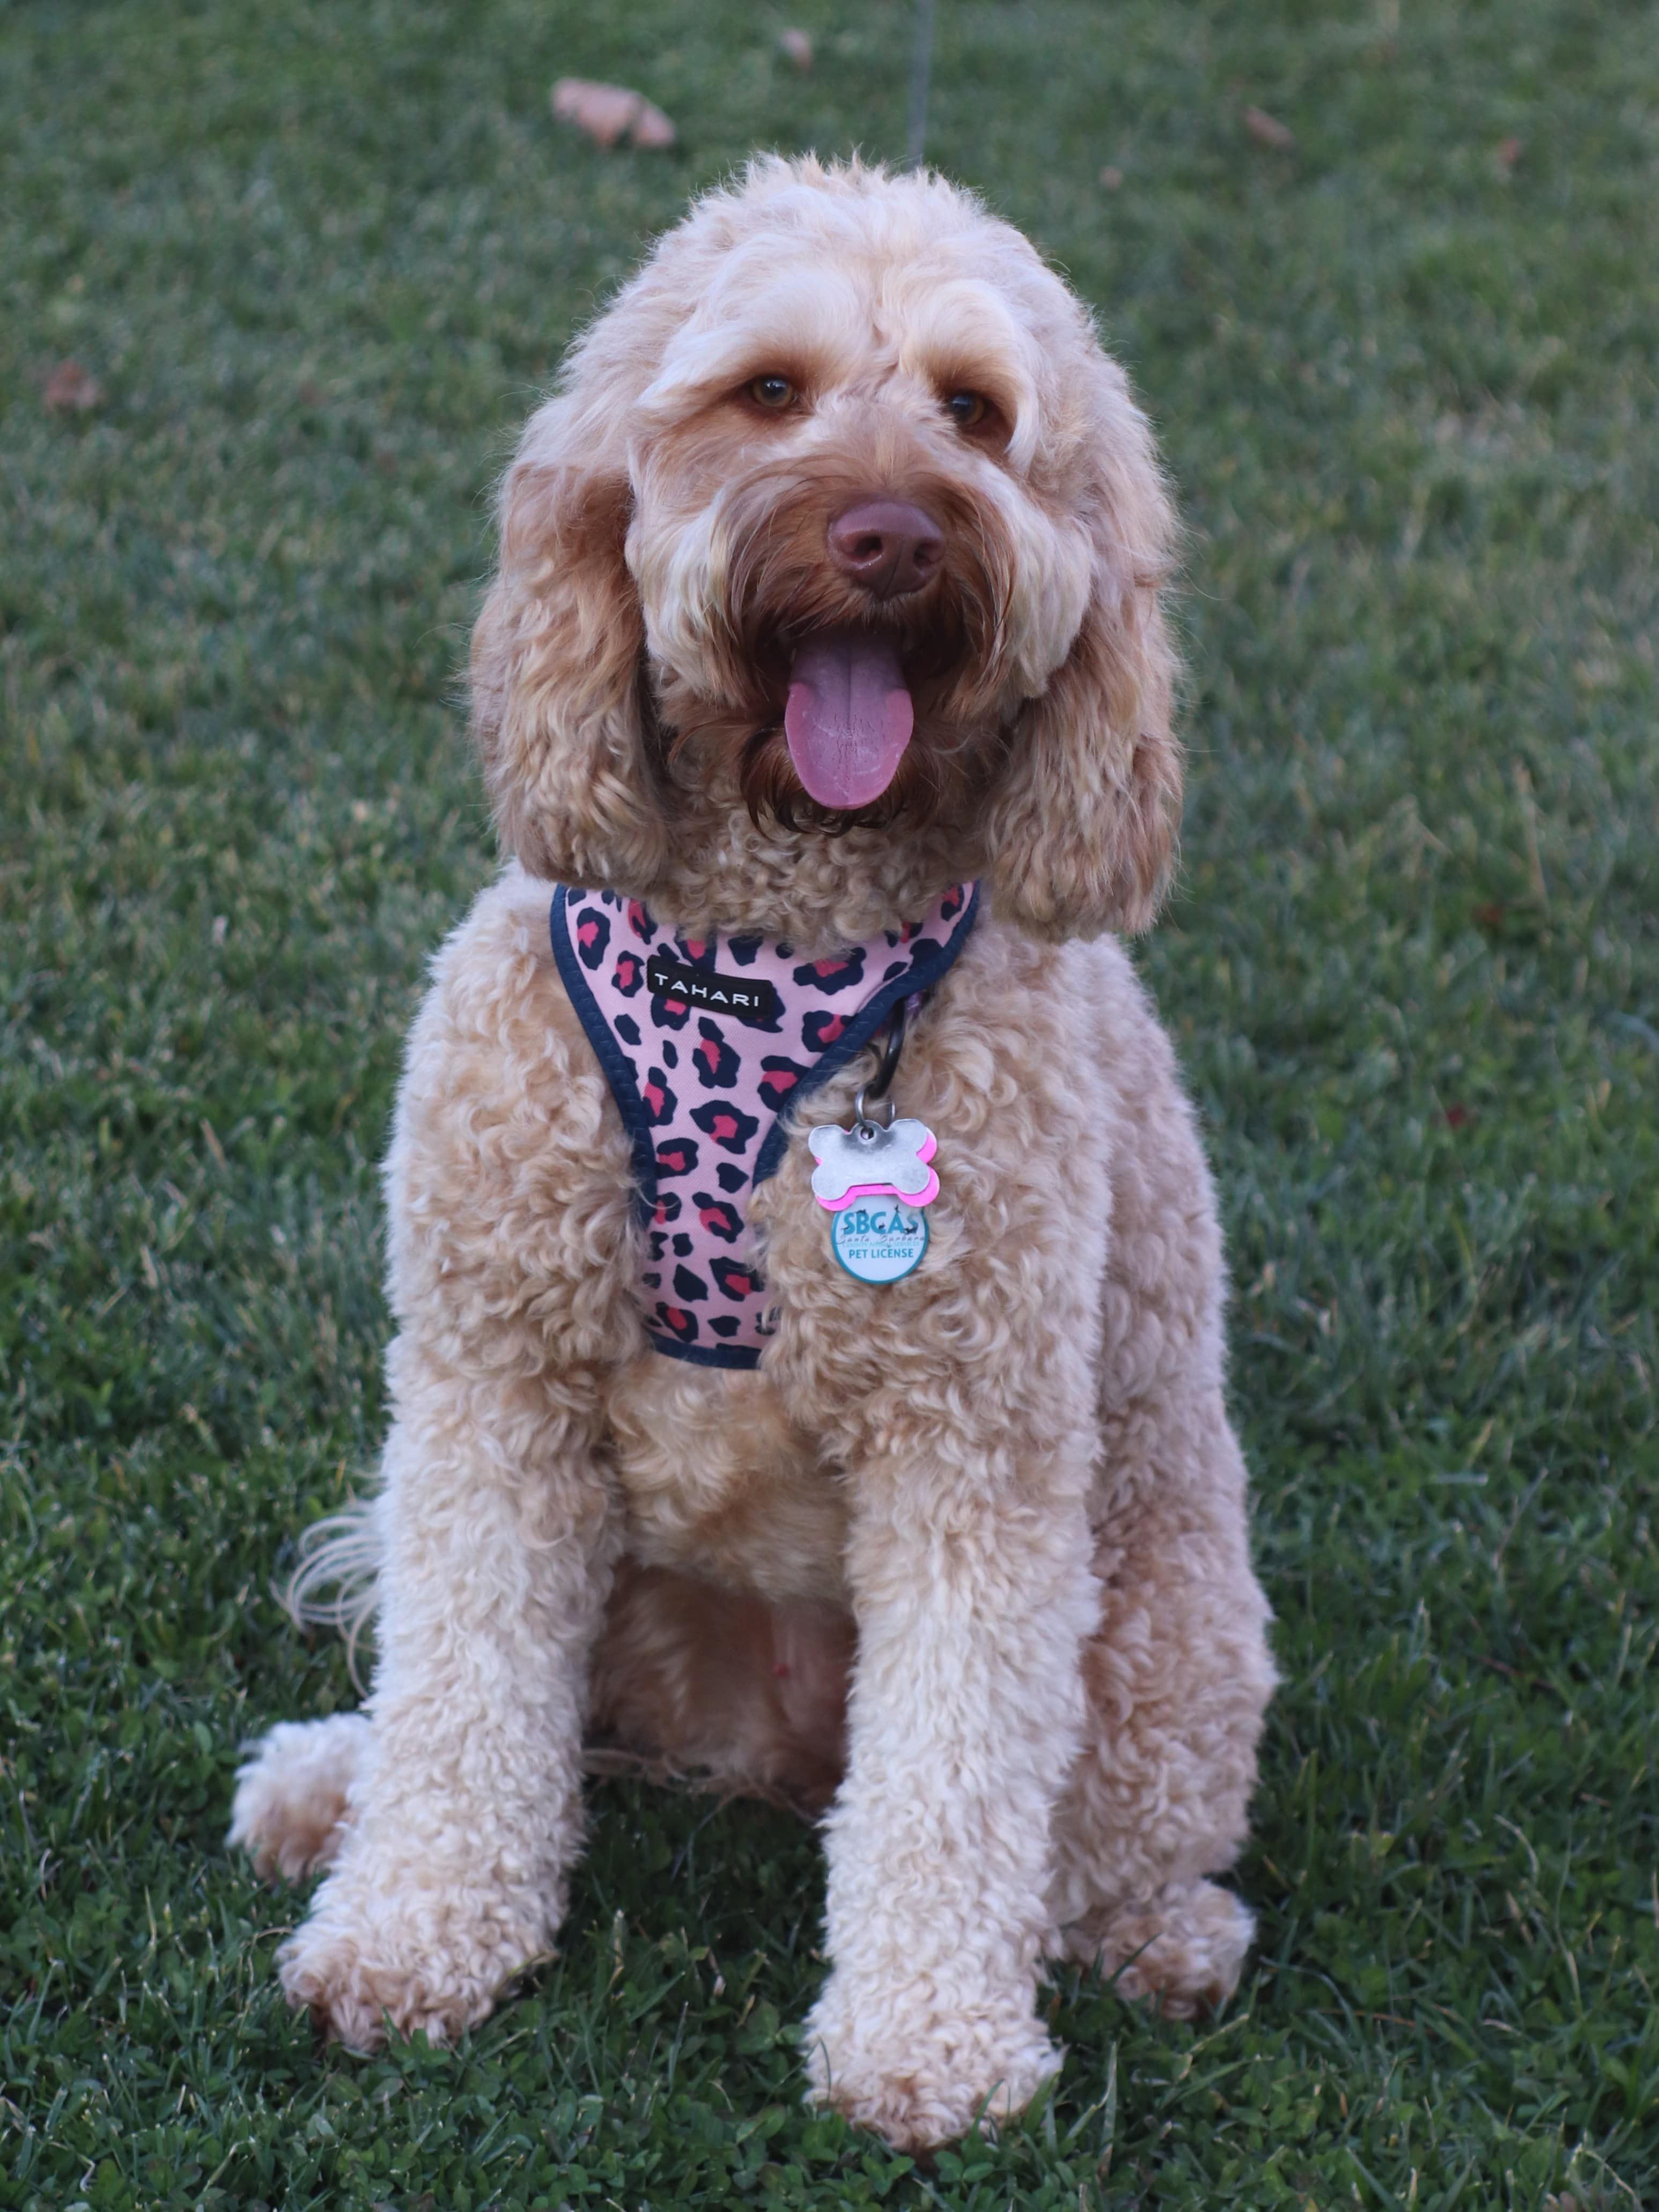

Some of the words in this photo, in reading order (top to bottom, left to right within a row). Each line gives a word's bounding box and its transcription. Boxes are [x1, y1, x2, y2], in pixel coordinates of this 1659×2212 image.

[654, 973, 759, 1007] TAHARI
[849, 1249, 868, 1258] PET
[871, 1248, 914, 1258] LICENSE
